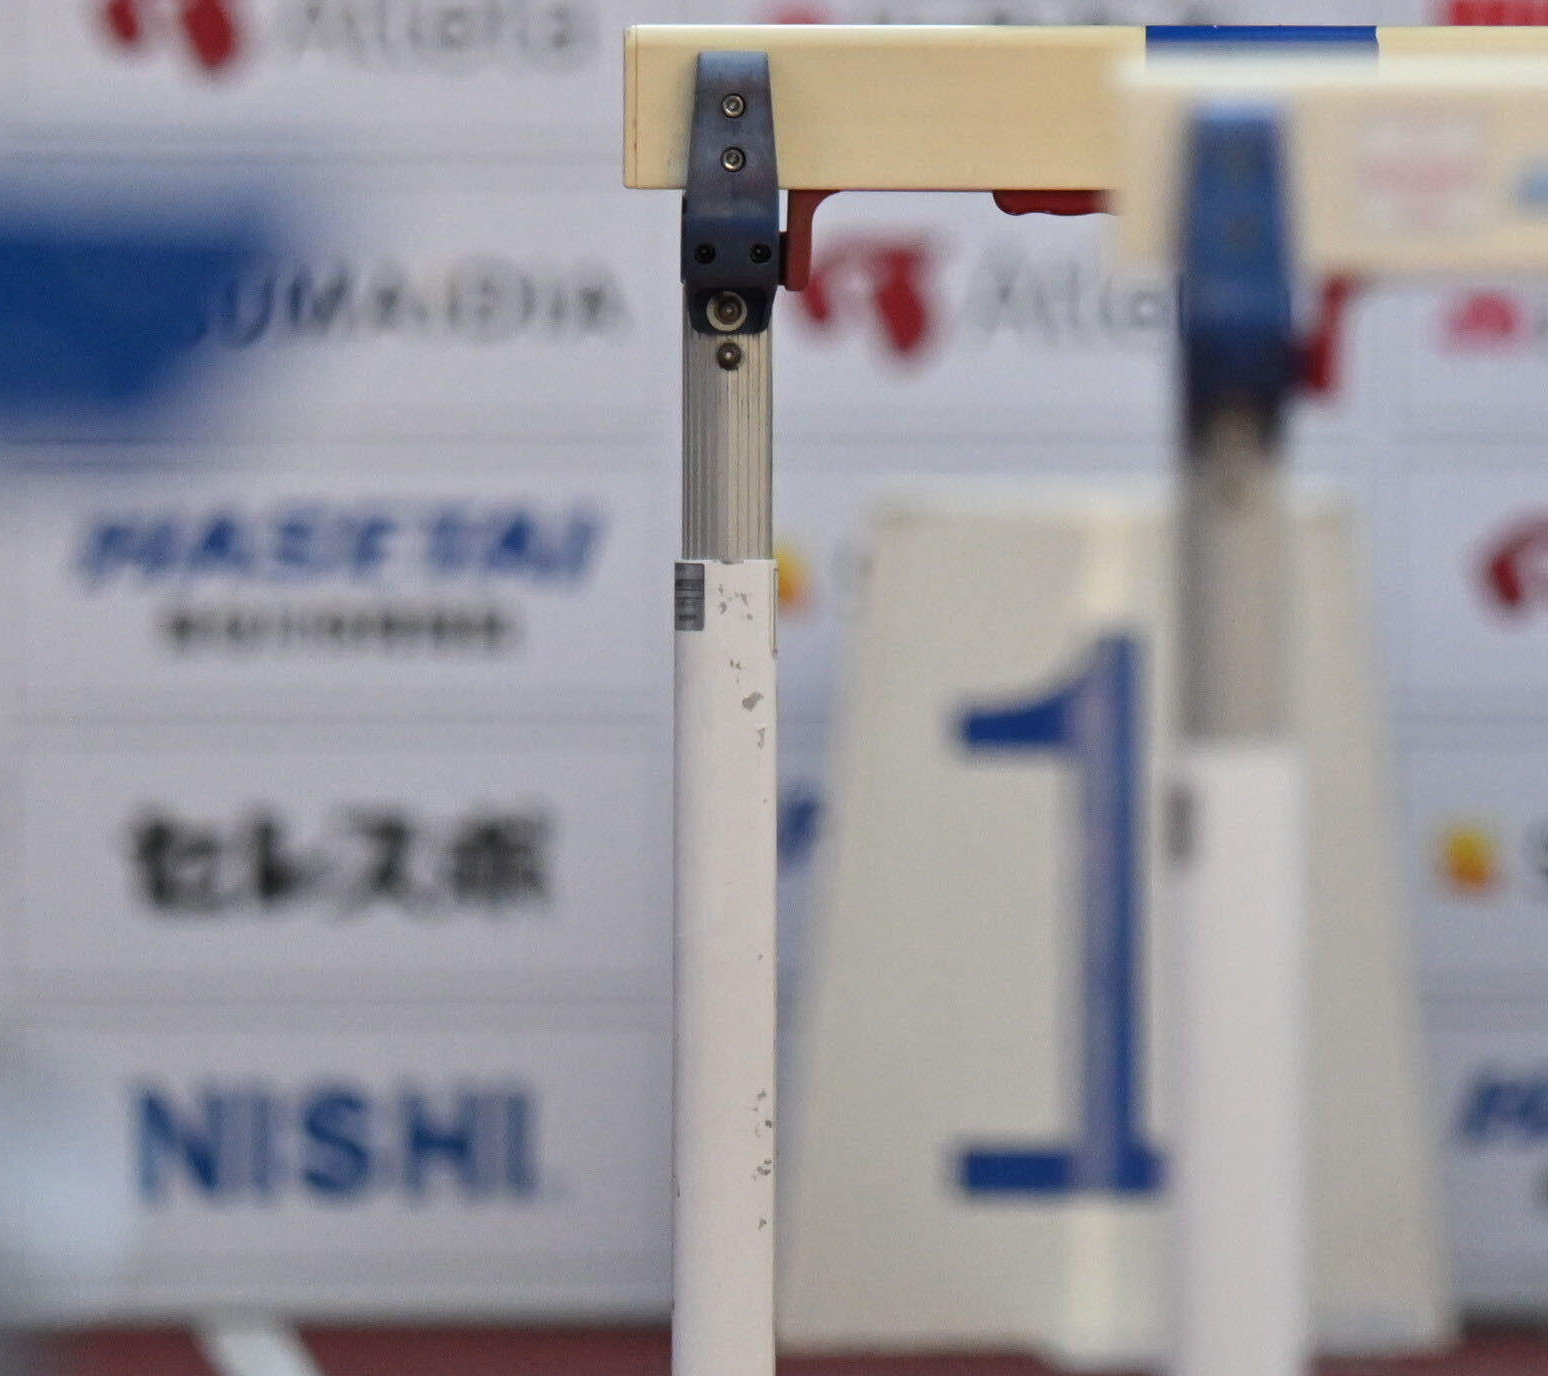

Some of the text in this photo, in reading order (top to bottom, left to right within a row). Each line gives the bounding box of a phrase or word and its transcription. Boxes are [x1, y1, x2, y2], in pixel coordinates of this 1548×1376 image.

[77, 504, 602, 586] HASETAI
[128, 808, 552, 918] セレスポ
[958, 634, 1162, 1193] 1
[134, 1082, 540, 1204] NISHI
